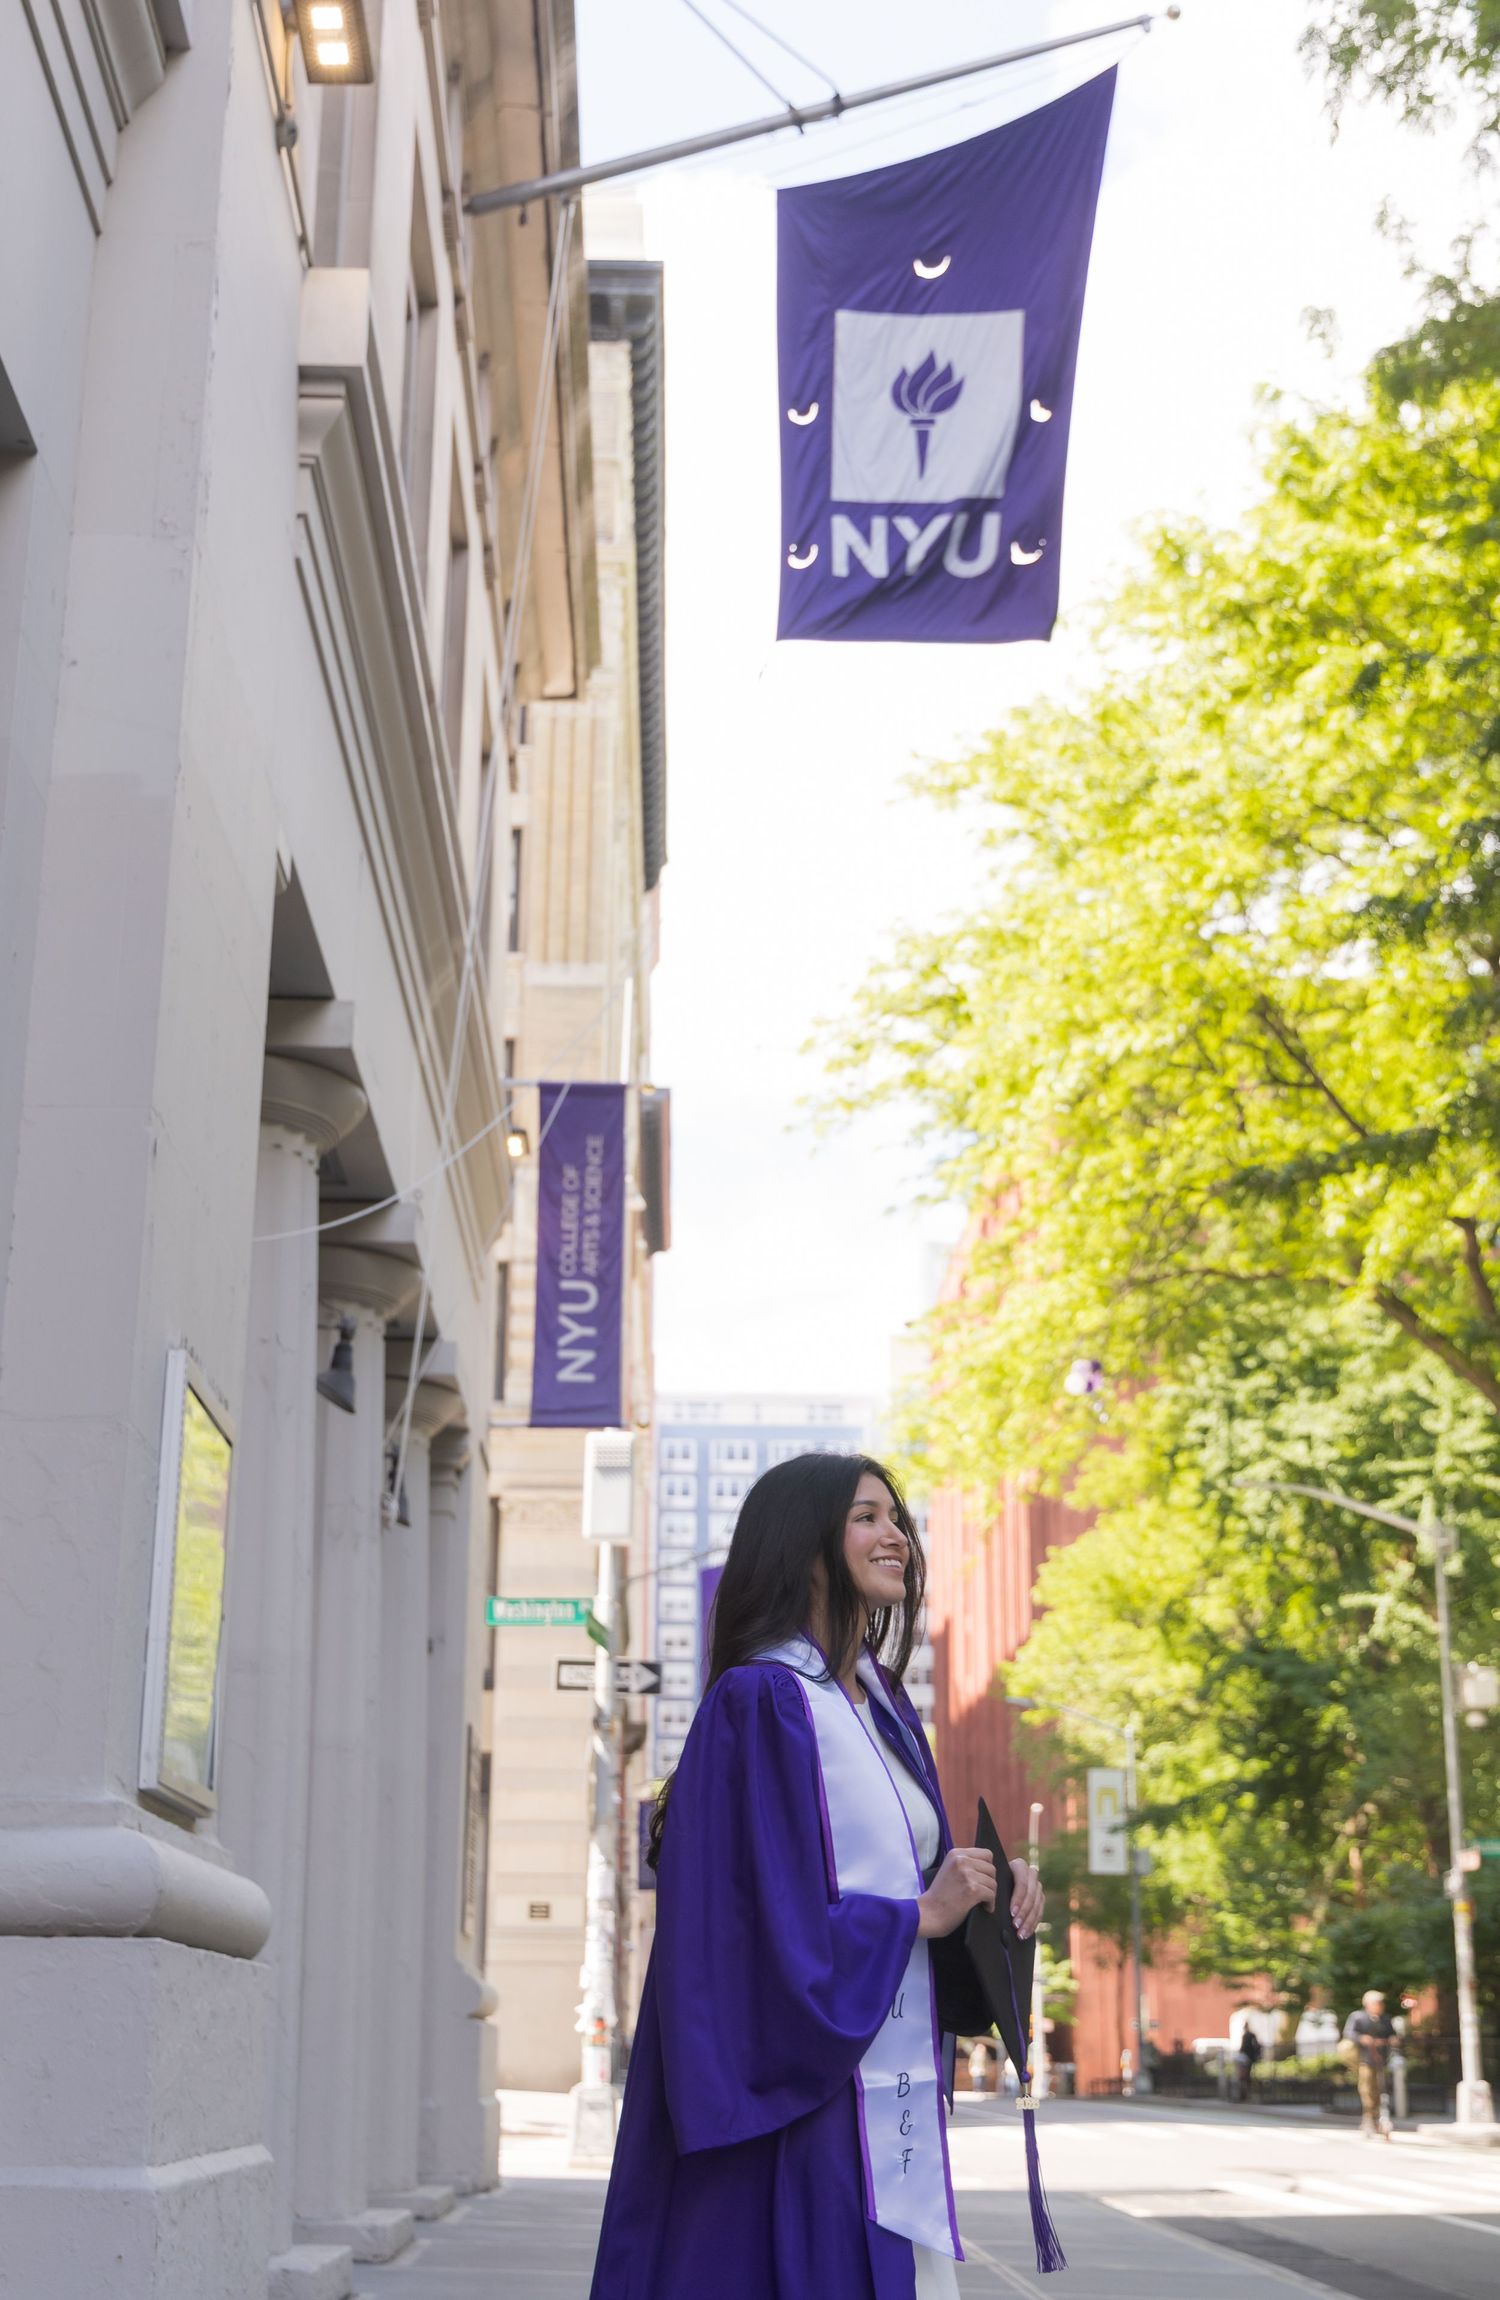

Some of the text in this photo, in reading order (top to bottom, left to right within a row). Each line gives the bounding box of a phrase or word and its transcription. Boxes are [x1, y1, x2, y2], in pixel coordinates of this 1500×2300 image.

[830, 511, 1002, 579] NYU
[583, 1134, 605, 1210] SCIENCE
[559, 1163, 580, 1277] COLLEGE OF
[582, 1226, 601, 1277] ARTS
[556, 1279, 599, 1383] NYU
[493, 1599, 575, 1622] Washington
